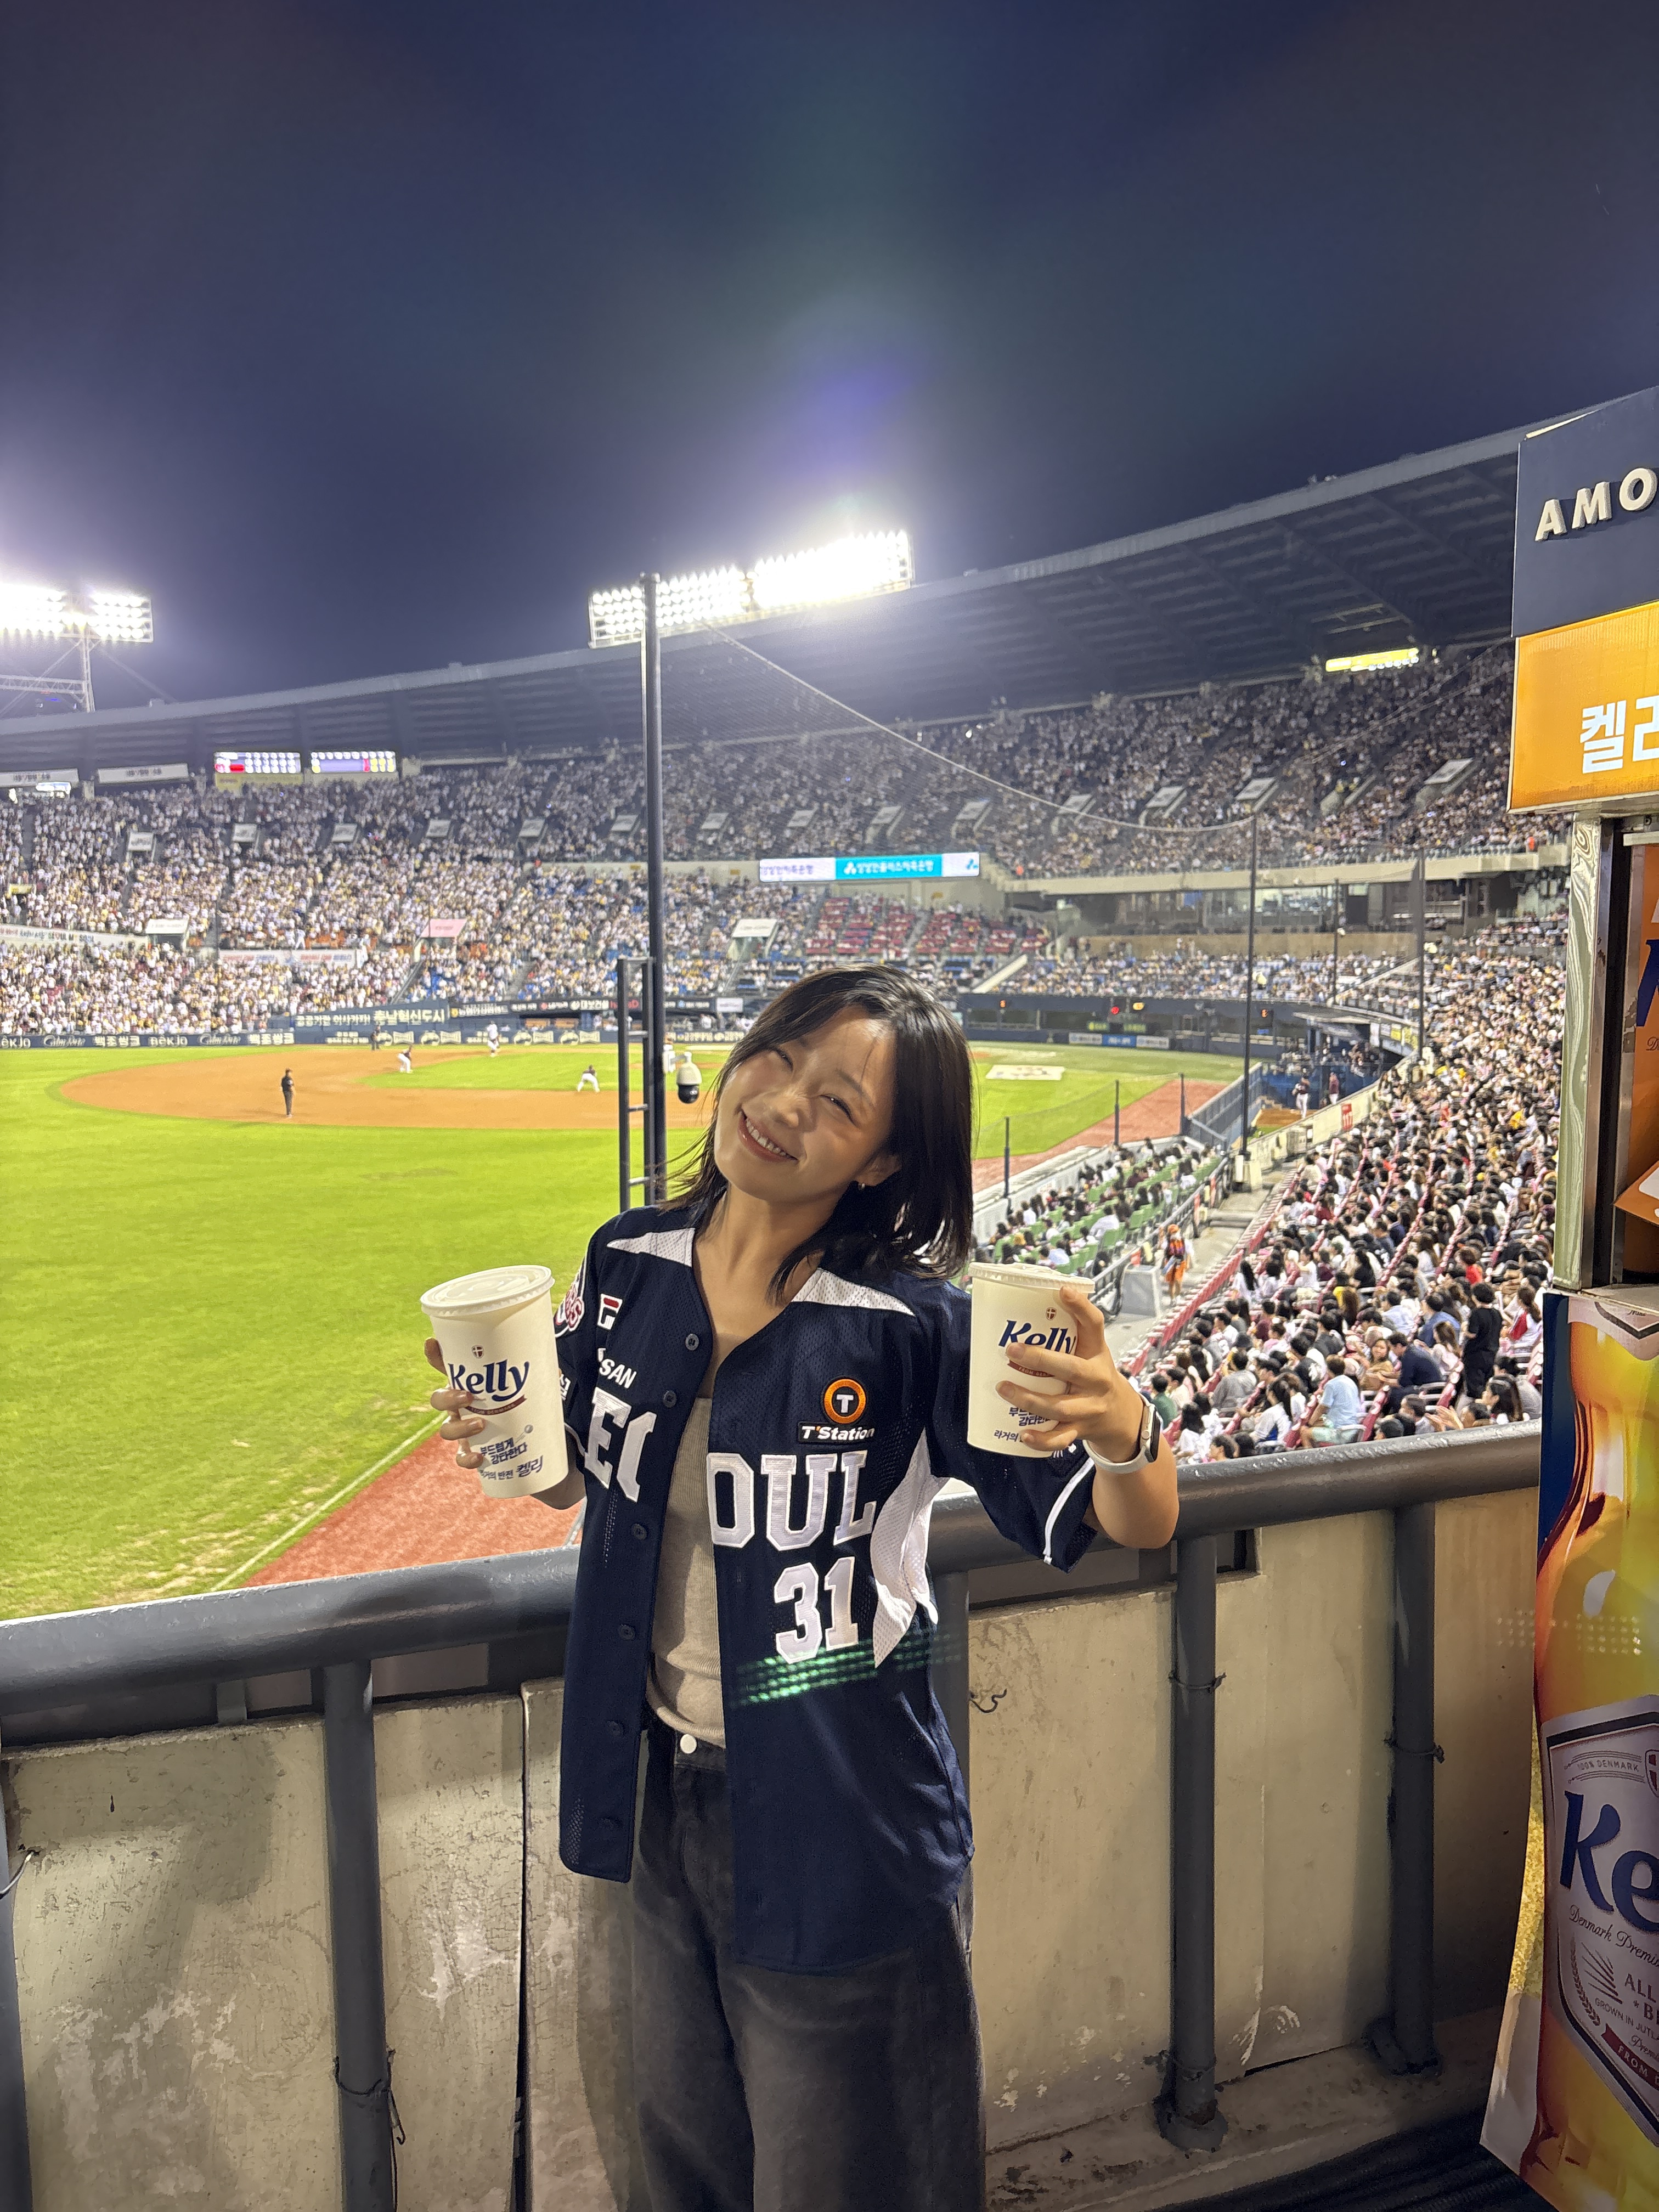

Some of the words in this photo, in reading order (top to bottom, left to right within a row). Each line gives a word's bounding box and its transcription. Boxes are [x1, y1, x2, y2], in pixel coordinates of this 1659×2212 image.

[1534, 467, 1657, 542] AMO
[448, 1358, 530, 1402] Kelly
[836, 1394, 854, 1413] T
[480, 1437, 515, 1457] 부드럽게
[802, 1426, 875, 1441] T'Station
[994, 1430, 1019, 1442] 라거의
[490, 1442, 528, 1465] 강타한다
[498, 1469, 514, 1480] 반전
[516, 1455, 543, 1477] 켈리
[774, 1556, 860, 1664] 31
[1596, 1759, 1639, 1773] DENMARK
[1569, 1904, 1612, 1942] Denmark
[1624, 1973, 1657, 2004] ALL
[1595, 1997, 1624, 2021] GROWN
[1625, 2015, 1634, 2027] IN
[1618, 2045, 1649, 2078] FROM
